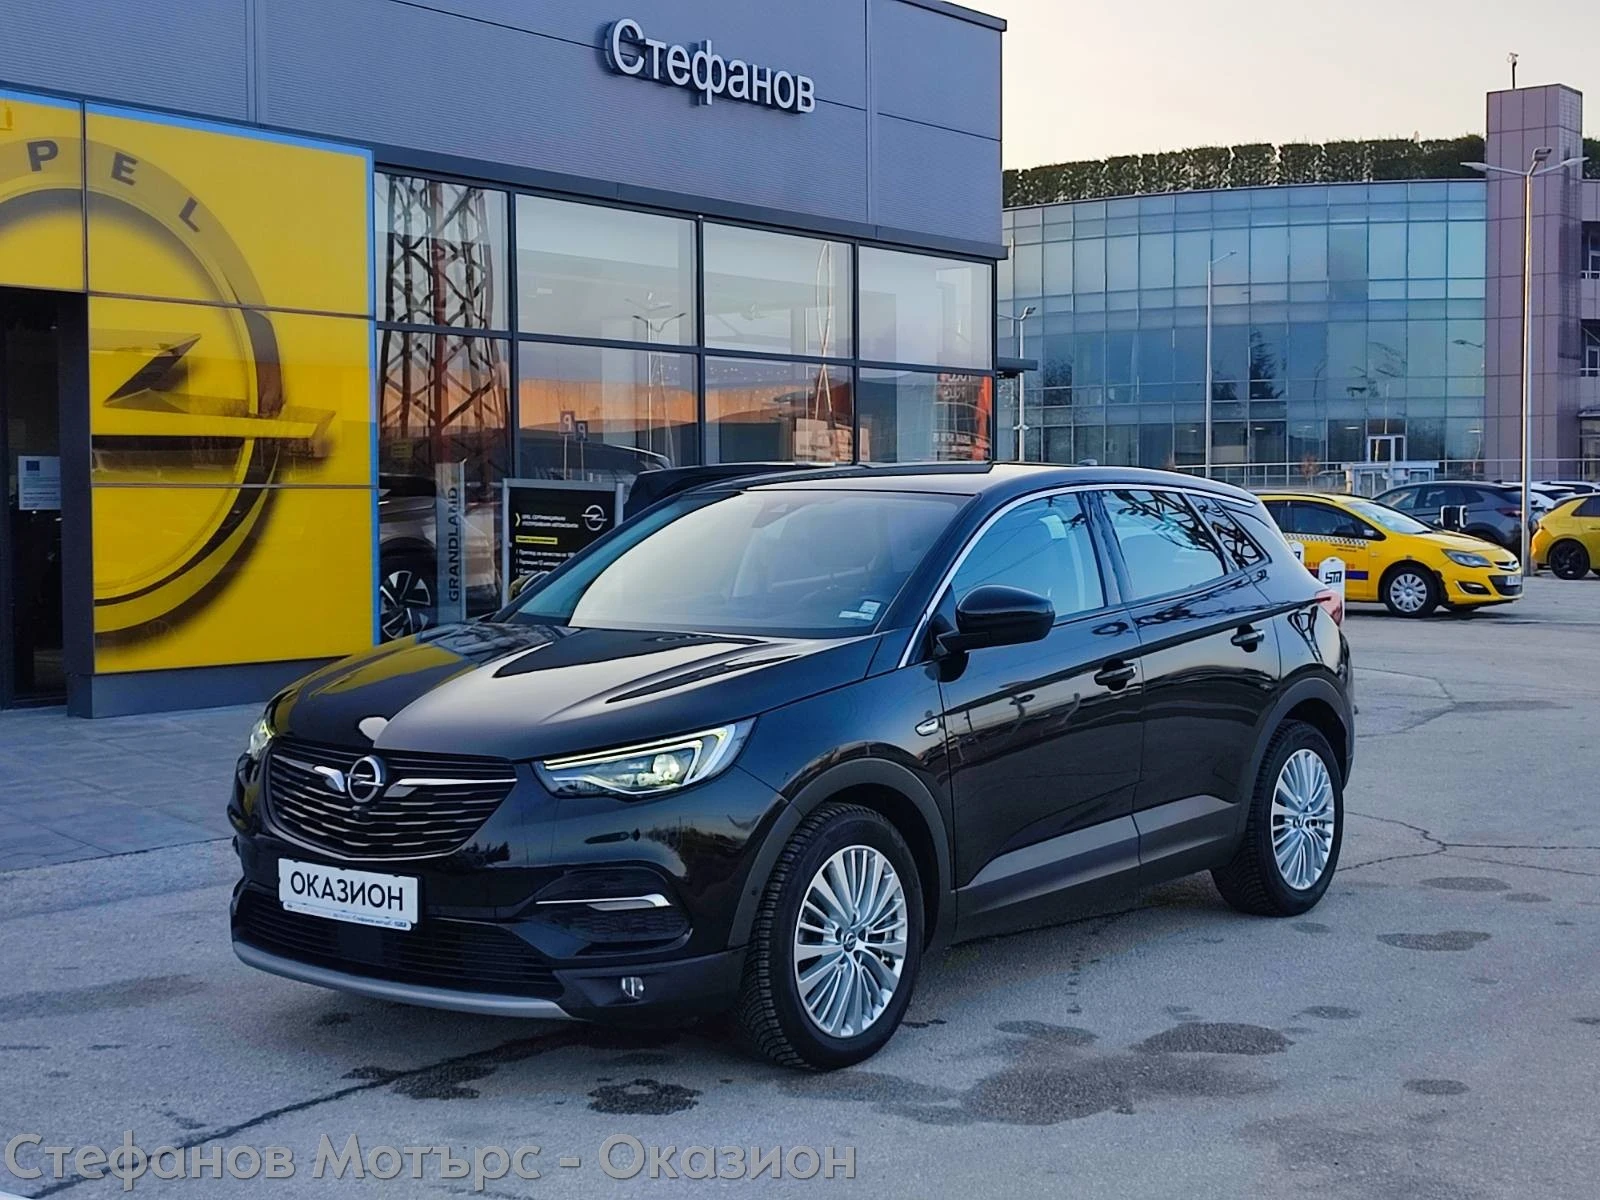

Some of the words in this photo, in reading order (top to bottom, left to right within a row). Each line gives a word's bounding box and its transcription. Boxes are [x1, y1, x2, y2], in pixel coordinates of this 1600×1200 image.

[610, 18, 815, 113] Стефанов
[447, 487, 460, 602] GRANDLAND
[290, 871, 403, 911] ОКАЗИОН
